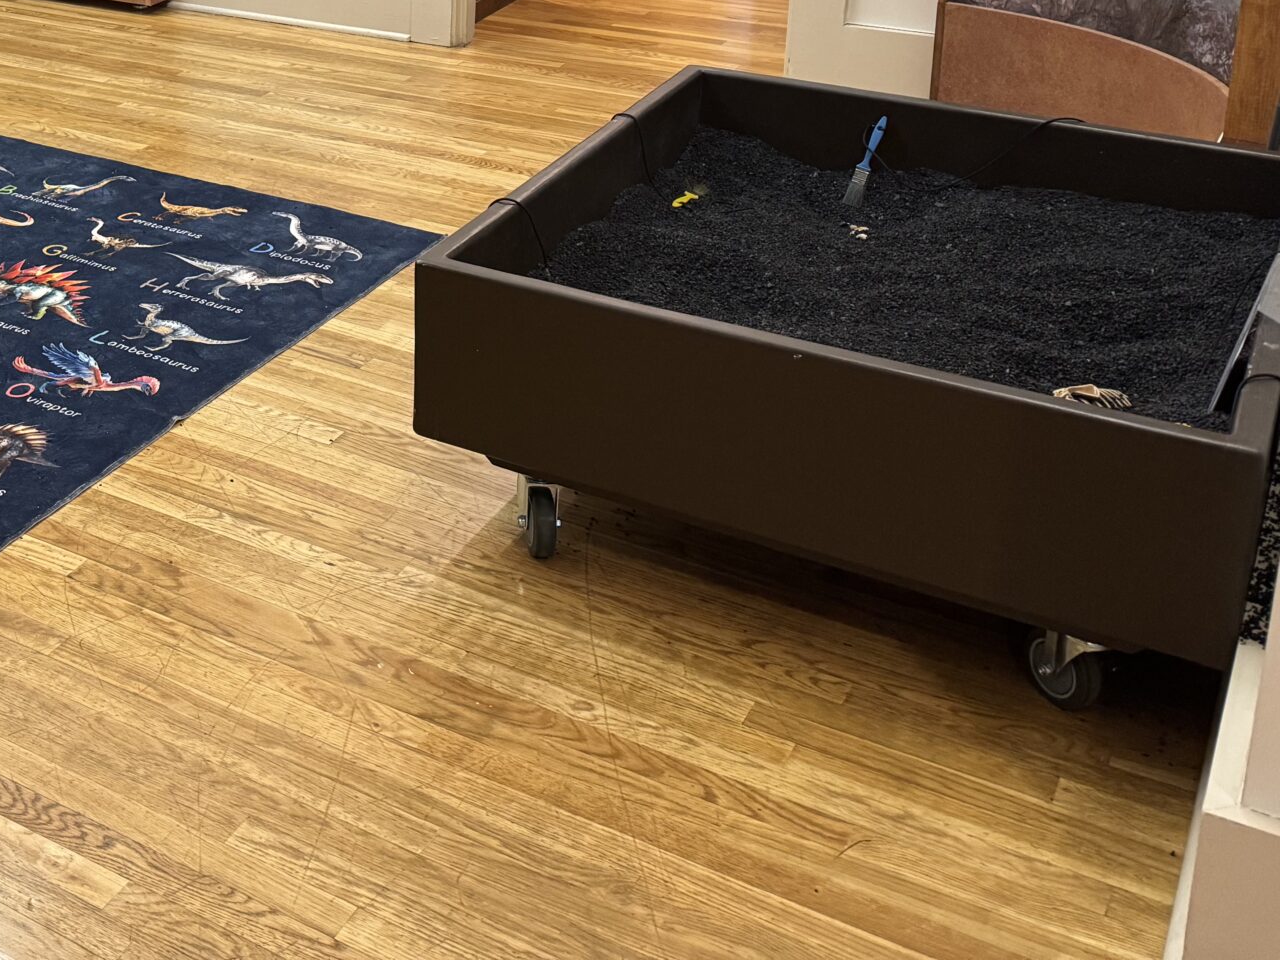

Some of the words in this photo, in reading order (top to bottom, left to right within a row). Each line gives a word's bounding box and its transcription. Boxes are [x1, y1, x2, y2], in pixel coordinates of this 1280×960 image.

[117, 212, 203, 239] Ceratosaurus
[42, 244, 118, 272] Gallimimus
[249, 242, 332, 270] Diplodocus
[140, 278, 243, 315] Herrerasaurus
[89, 330, 200, 374] Lambeosaurus
[5, 382, 82, 419] Oviraptor
